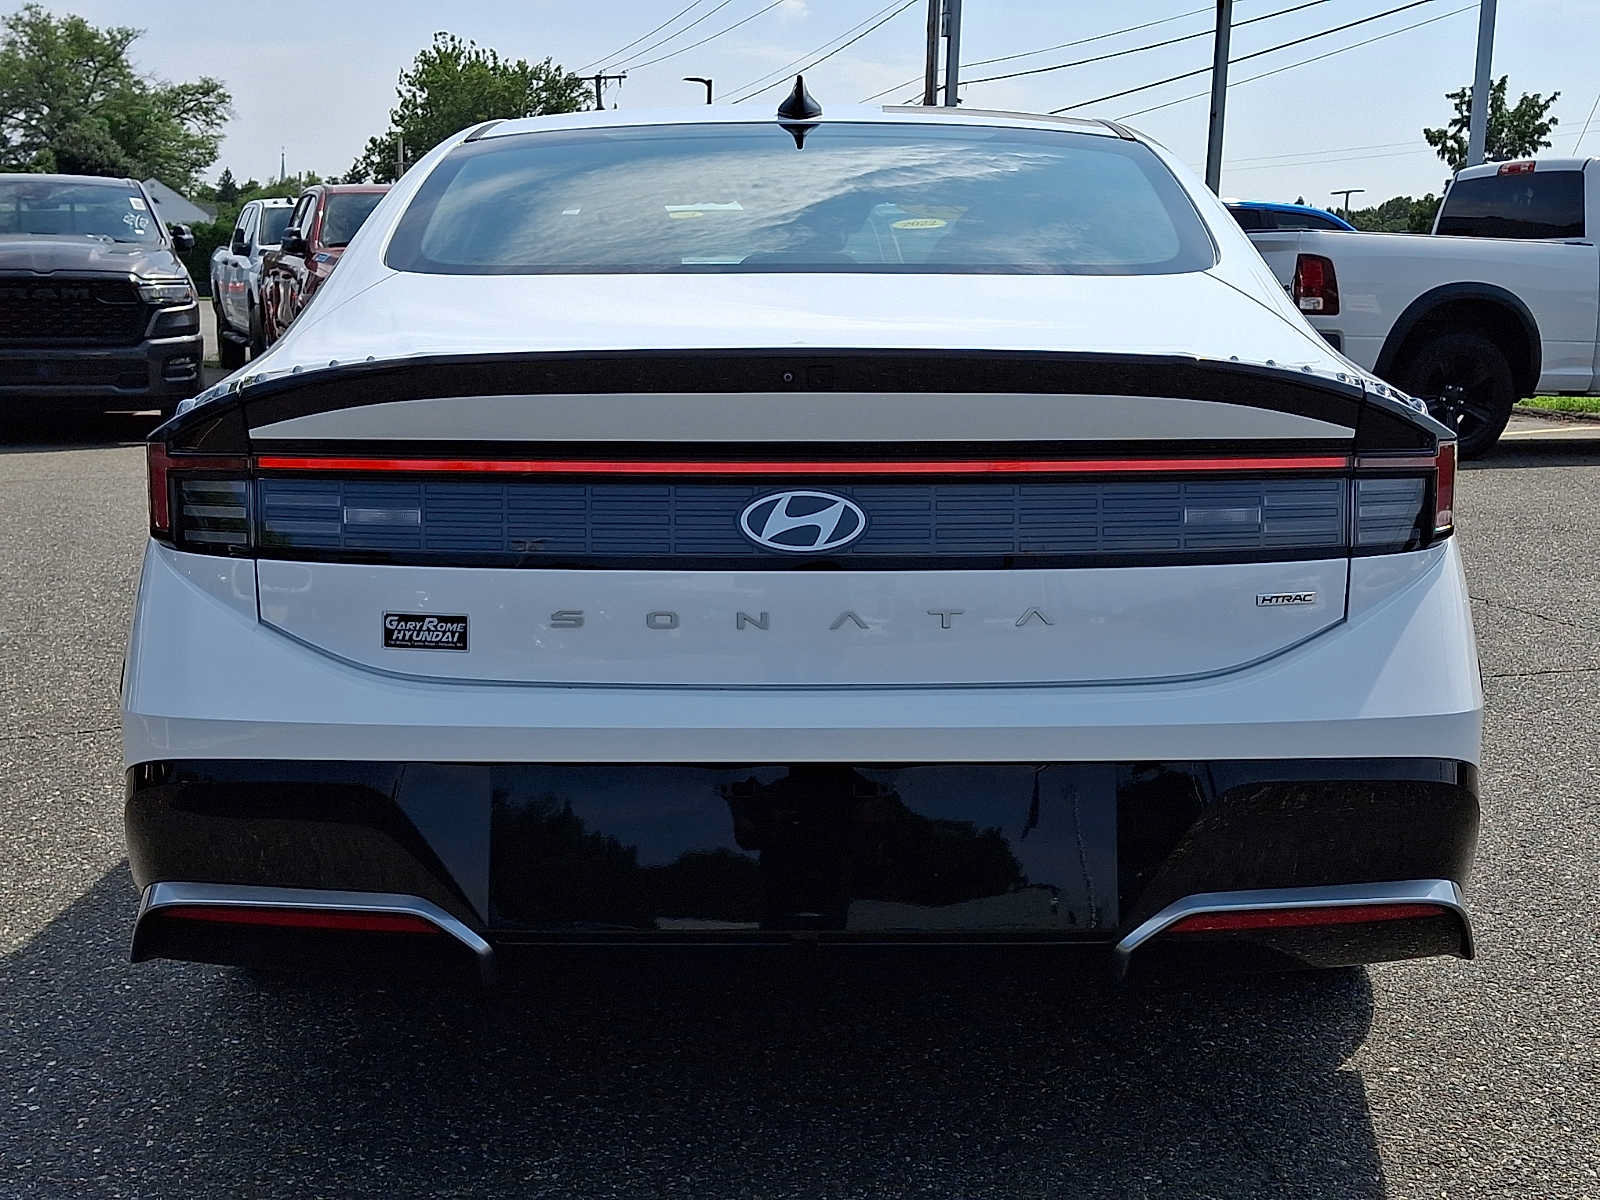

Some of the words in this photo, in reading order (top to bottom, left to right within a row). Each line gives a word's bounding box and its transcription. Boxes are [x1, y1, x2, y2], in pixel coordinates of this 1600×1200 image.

[1261, 594, 1313, 604] HTRAC
[550, 608, 1054, 630] SONATA
[392, 630, 459, 642] HYUNDAI
